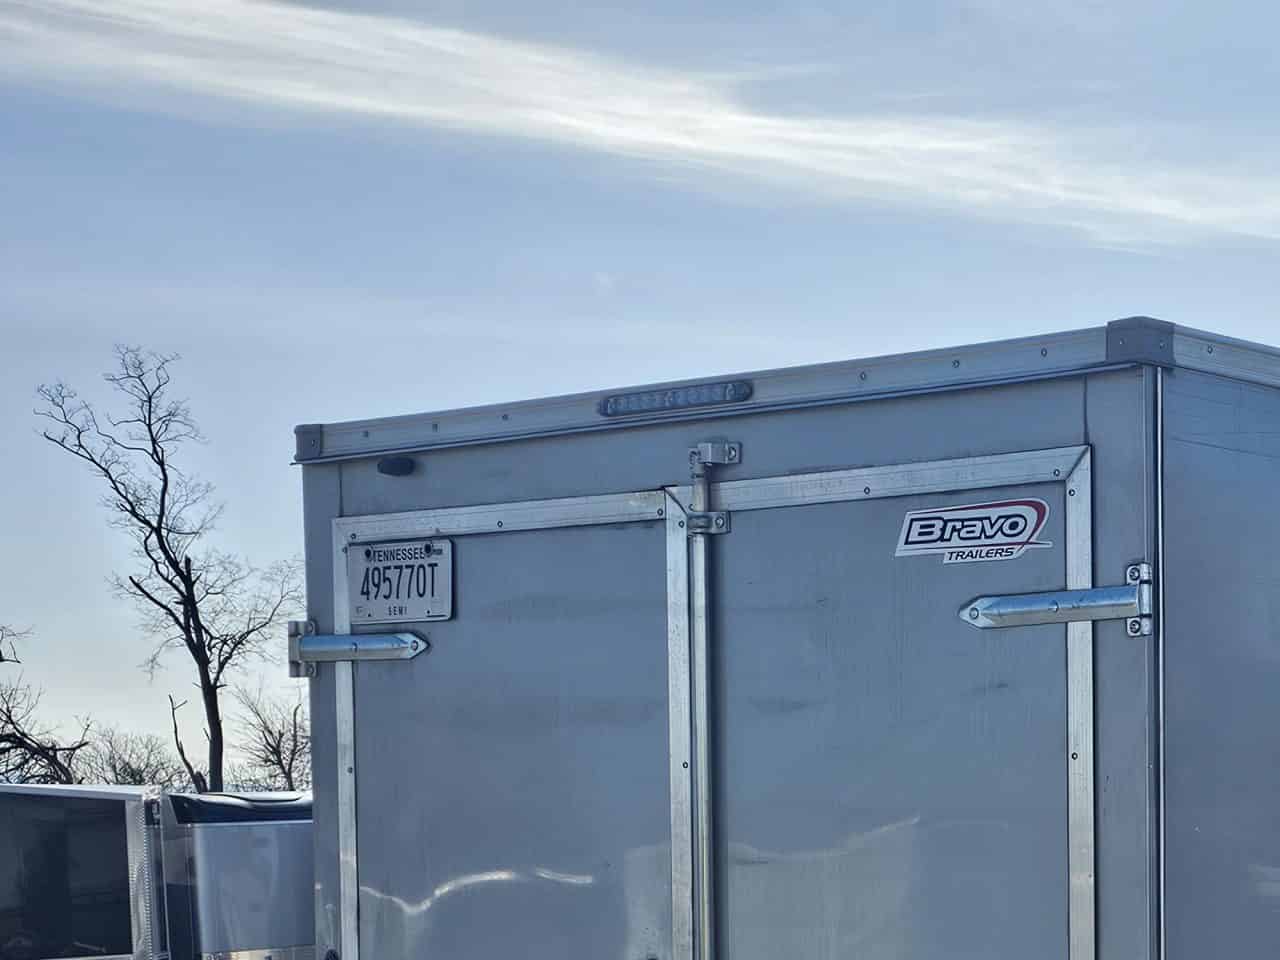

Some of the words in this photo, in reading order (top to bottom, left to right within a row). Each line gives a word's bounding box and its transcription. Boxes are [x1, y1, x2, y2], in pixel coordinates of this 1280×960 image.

[903, 513, 1028, 545] Bravo
[373, 547, 425, 562] TENNESSEE
[946, 547, 1015, 561] TRAILERS
[360, 562, 438, 601] 495770T
[388, 606, 408, 616] SEMI
